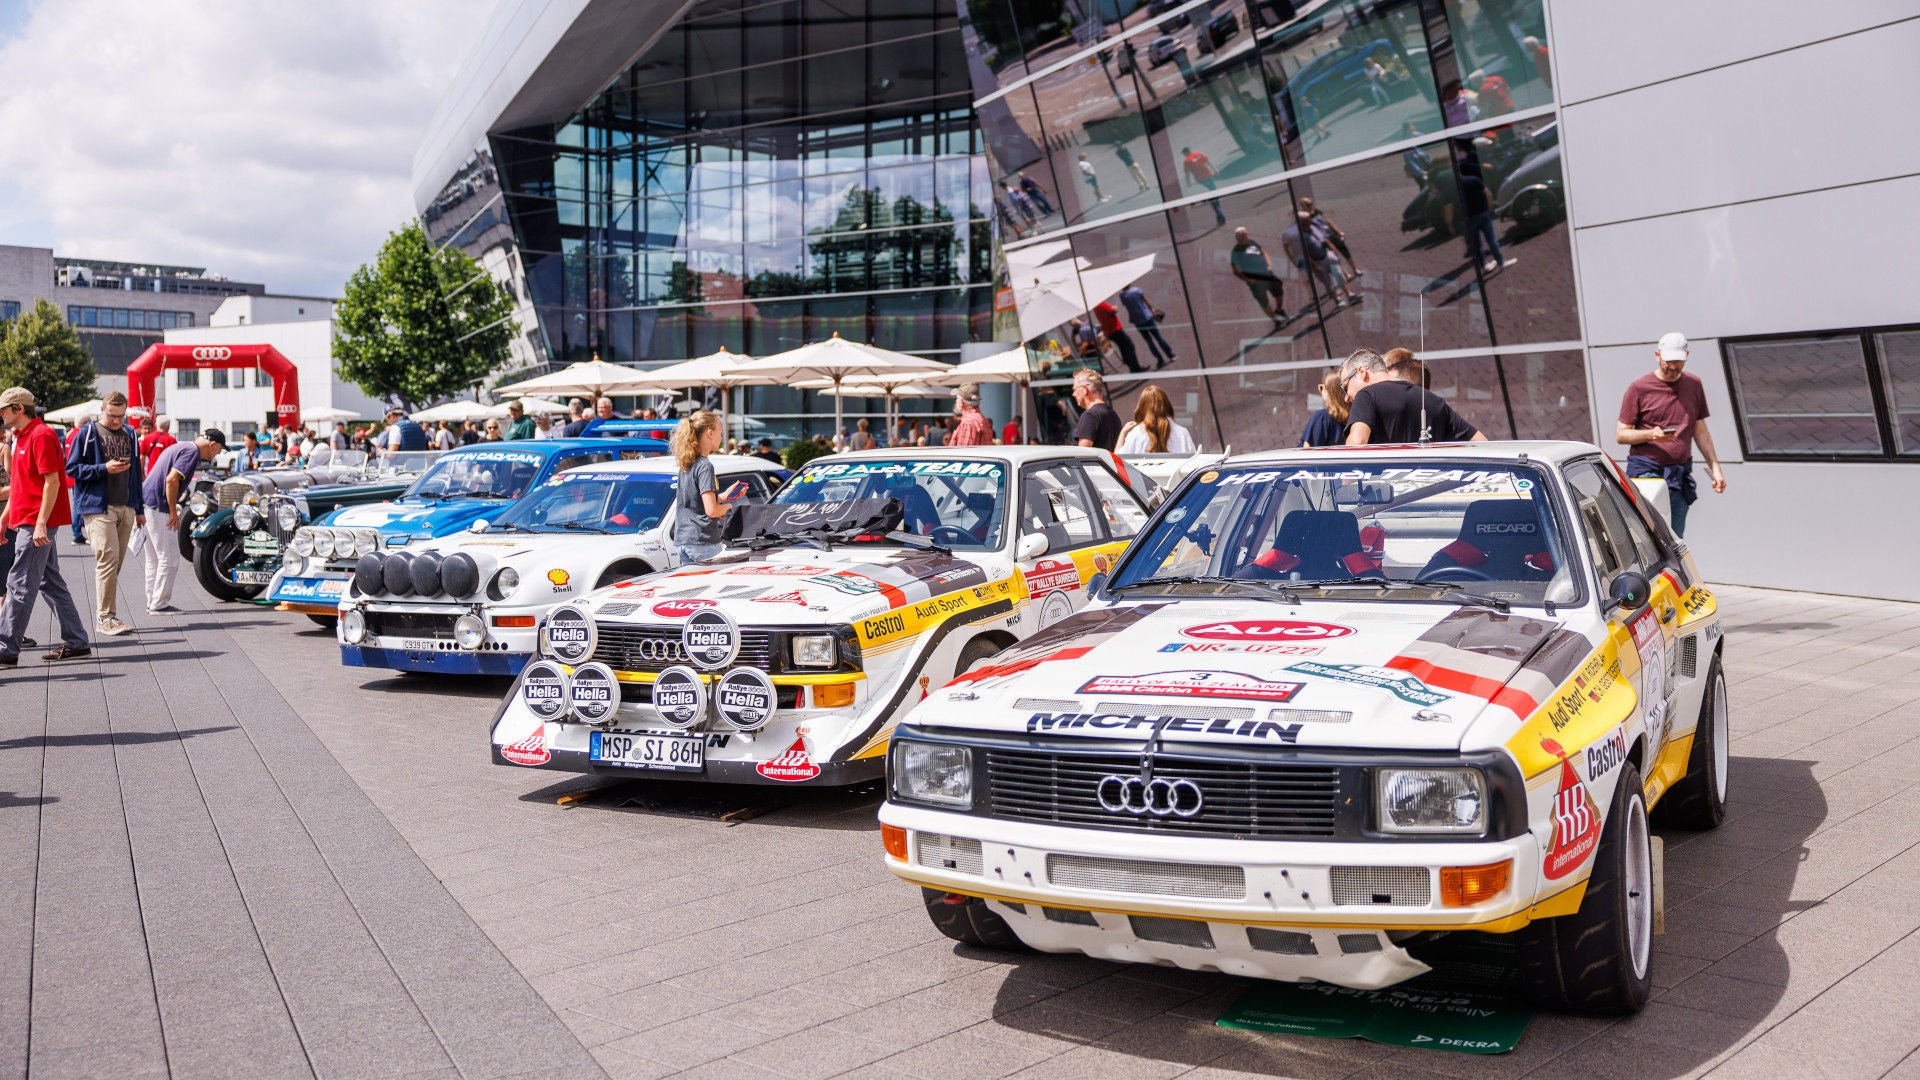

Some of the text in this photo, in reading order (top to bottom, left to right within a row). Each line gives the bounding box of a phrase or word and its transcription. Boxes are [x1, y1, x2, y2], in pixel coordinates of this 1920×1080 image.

[808, 462, 992, 477] HB Audi TEAM
[1216, 468, 1513, 487] HB Audi TEAM
[1475, 523, 1536, 534] RECARO
[1040, 560, 1055, 571] 1985
[864, 612, 905, 640] Castrol
[915, 602, 939, 619] Audi
[941, 595, 968, 613] Sport
[553, 628, 585, 640] Hella
[1194, 623, 1345, 638] Audi
[691, 633, 728, 645] Hella
[1134, 686, 1193, 694] Clarion
[1209, 681, 1288, 689] ZEALAND
[528, 686, 560, 698] Hella
[575, 688, 608, 700] Hella
[660, 692, 694, 705] Hella
[724, 695, 765, 707] Hella
[1548, 686, 1587, 733] Audi Sport
[1027, 712, 1304, 744] MICHELIN
[602, 735, 632, 759] MSP
[644, 739, 663, 761] SI
[669, 740, 701, 764] 86H
[1587, 727, 1626, 782] Castrol
[506, 750, 547, 762] international
[772, 750, 809, 767] HB
[763, 767, 814, 777] international
[1553, 781, 1590, 847] HB
[1552, 832, 1594, 872] international
[1439, 1038, 1501, 1048] DEKRA
